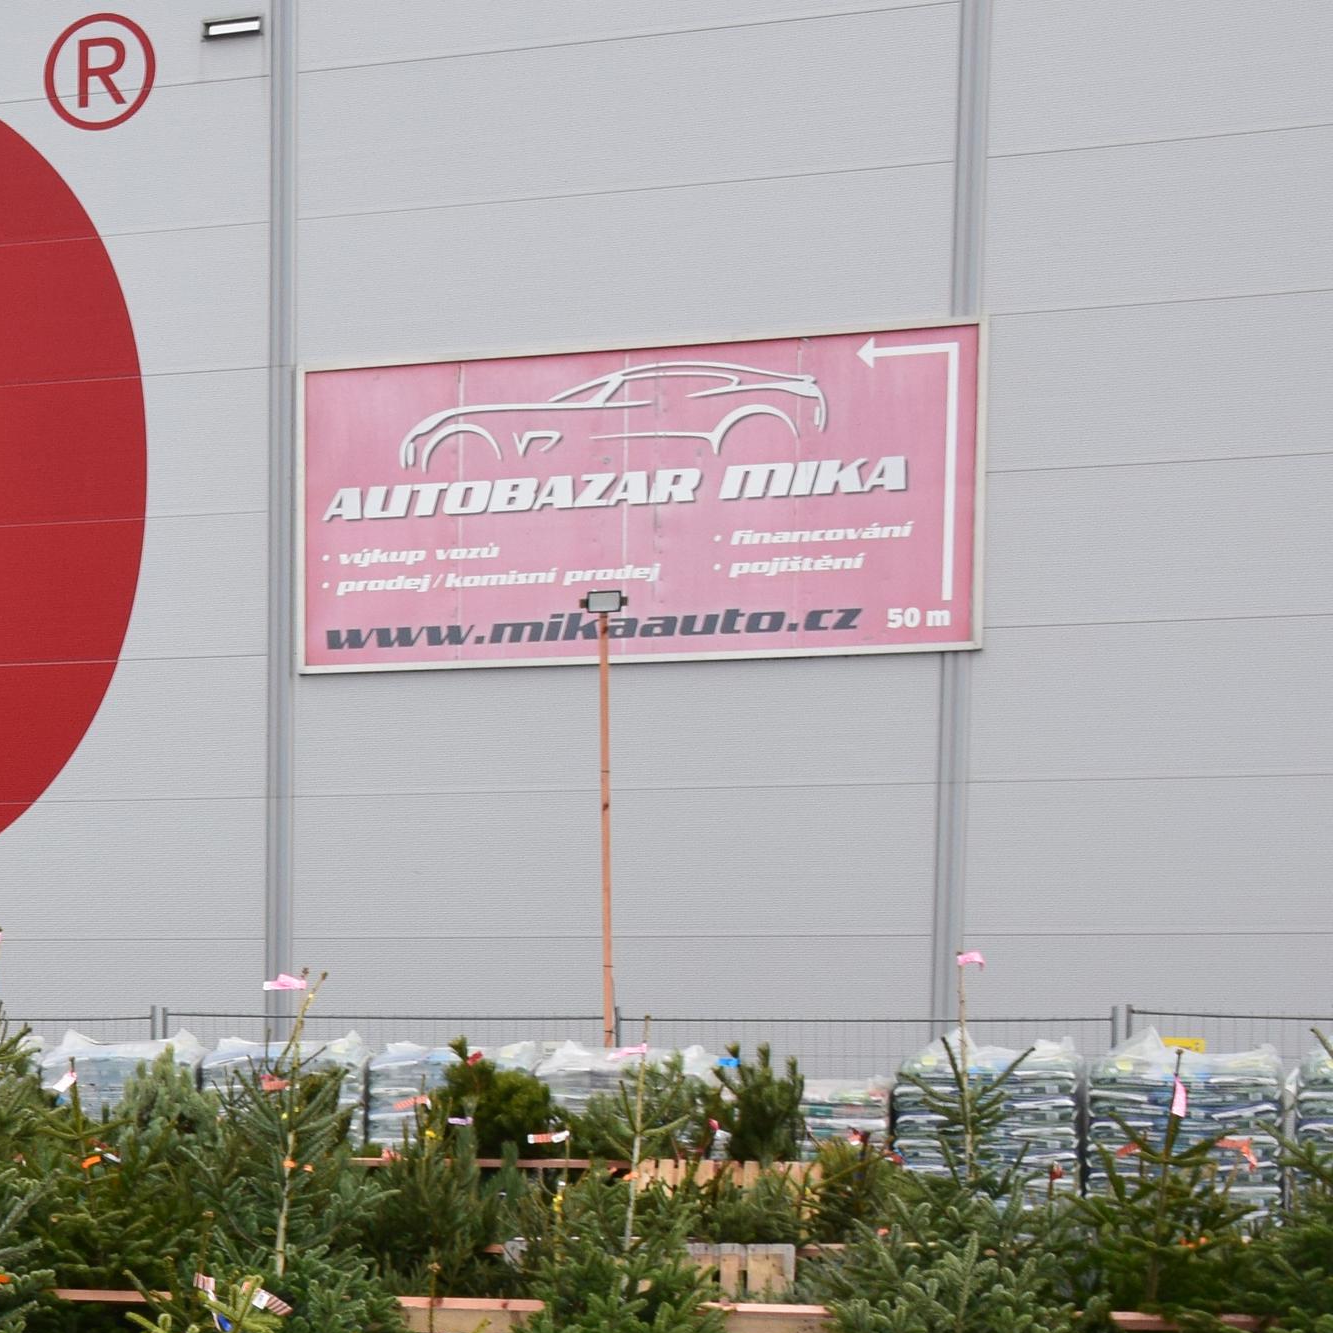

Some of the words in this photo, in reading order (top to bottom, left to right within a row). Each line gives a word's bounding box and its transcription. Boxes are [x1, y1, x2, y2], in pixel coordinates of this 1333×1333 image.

[322, 468, 701, 521] AUTOBAZAR
[718, 455, 907, 500] MIKA
[730, 521, 915, 545] financování
[339, 548, 427, 567] výkup
[435, 542, 501, 560] vozů
[729, 552, 866, 578] pojištění
[562, 563, 661, 586] prodej
[326, 608, 863, 650] www.mikaauto.cz
[887, 607, 921, 629] 50
[926, 609, 951, 627] m
